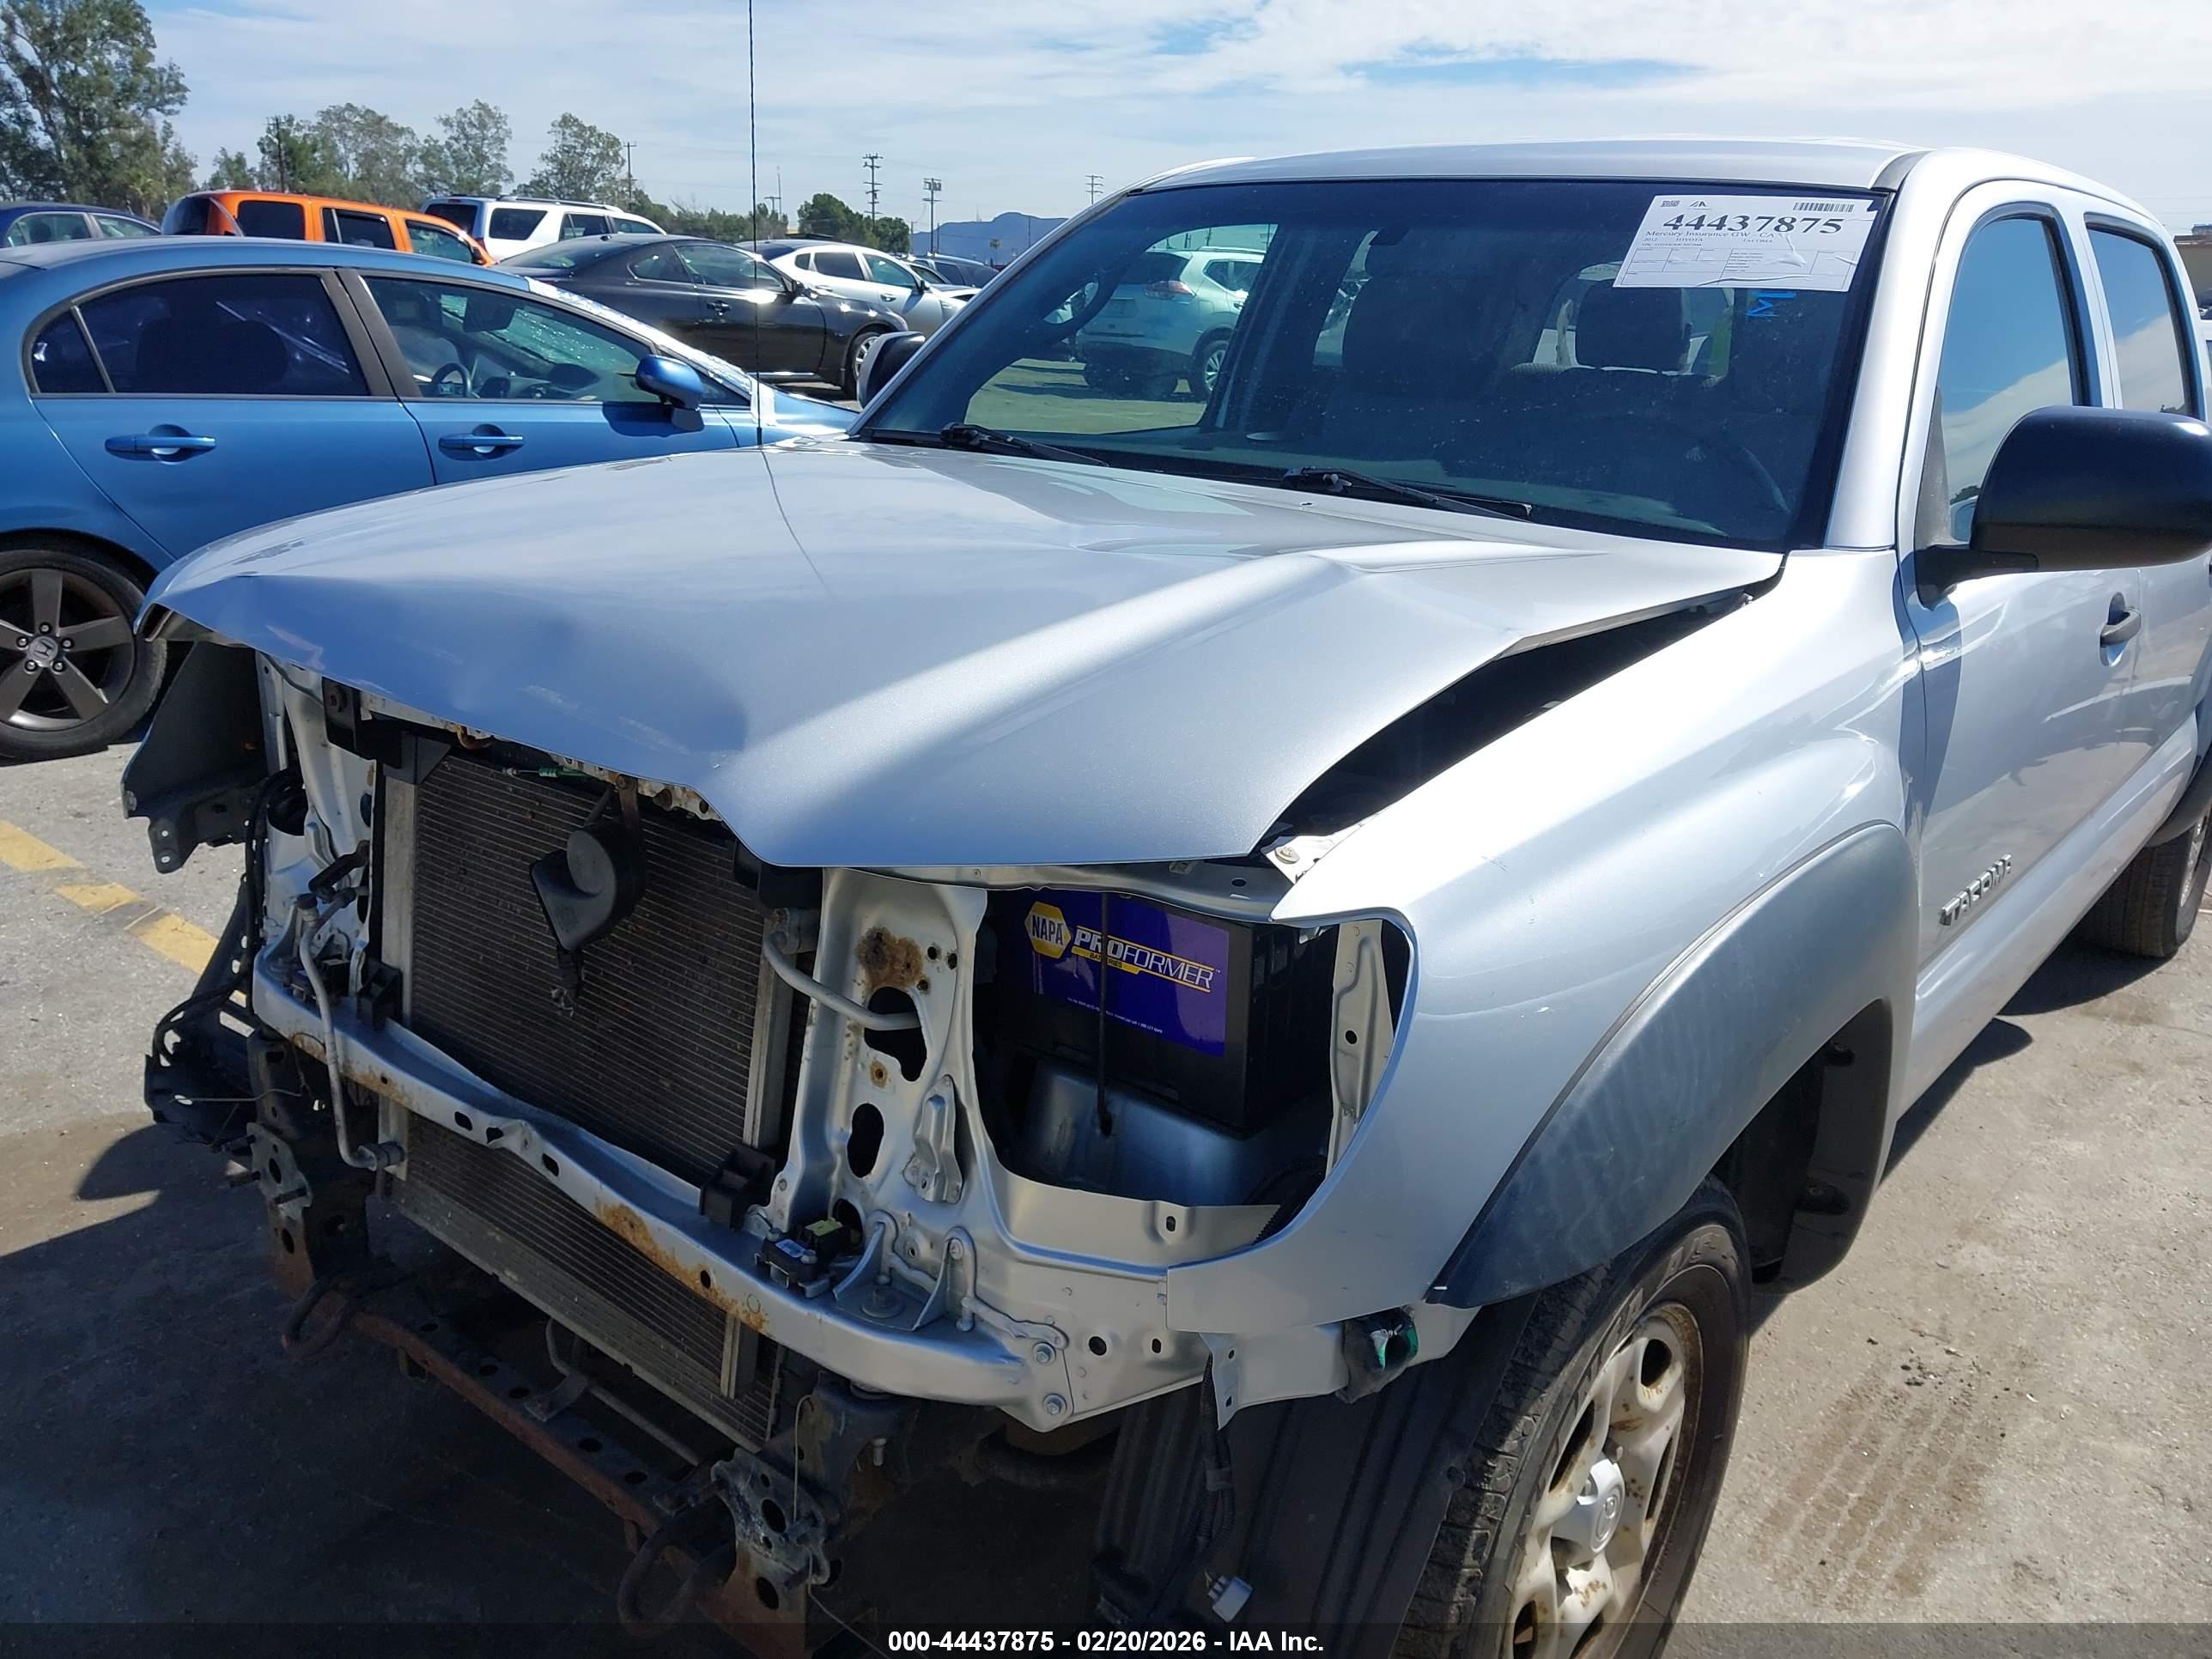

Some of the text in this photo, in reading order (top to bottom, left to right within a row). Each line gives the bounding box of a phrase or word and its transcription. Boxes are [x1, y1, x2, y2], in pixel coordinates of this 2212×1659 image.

[1663, 214, 1845, 234] 44437875
[1939, 854, 2012, 927] TACOMA
[1032, 915, 1063, 945] NAPA
[1074, 928, 1213, 988] PROFORMER
